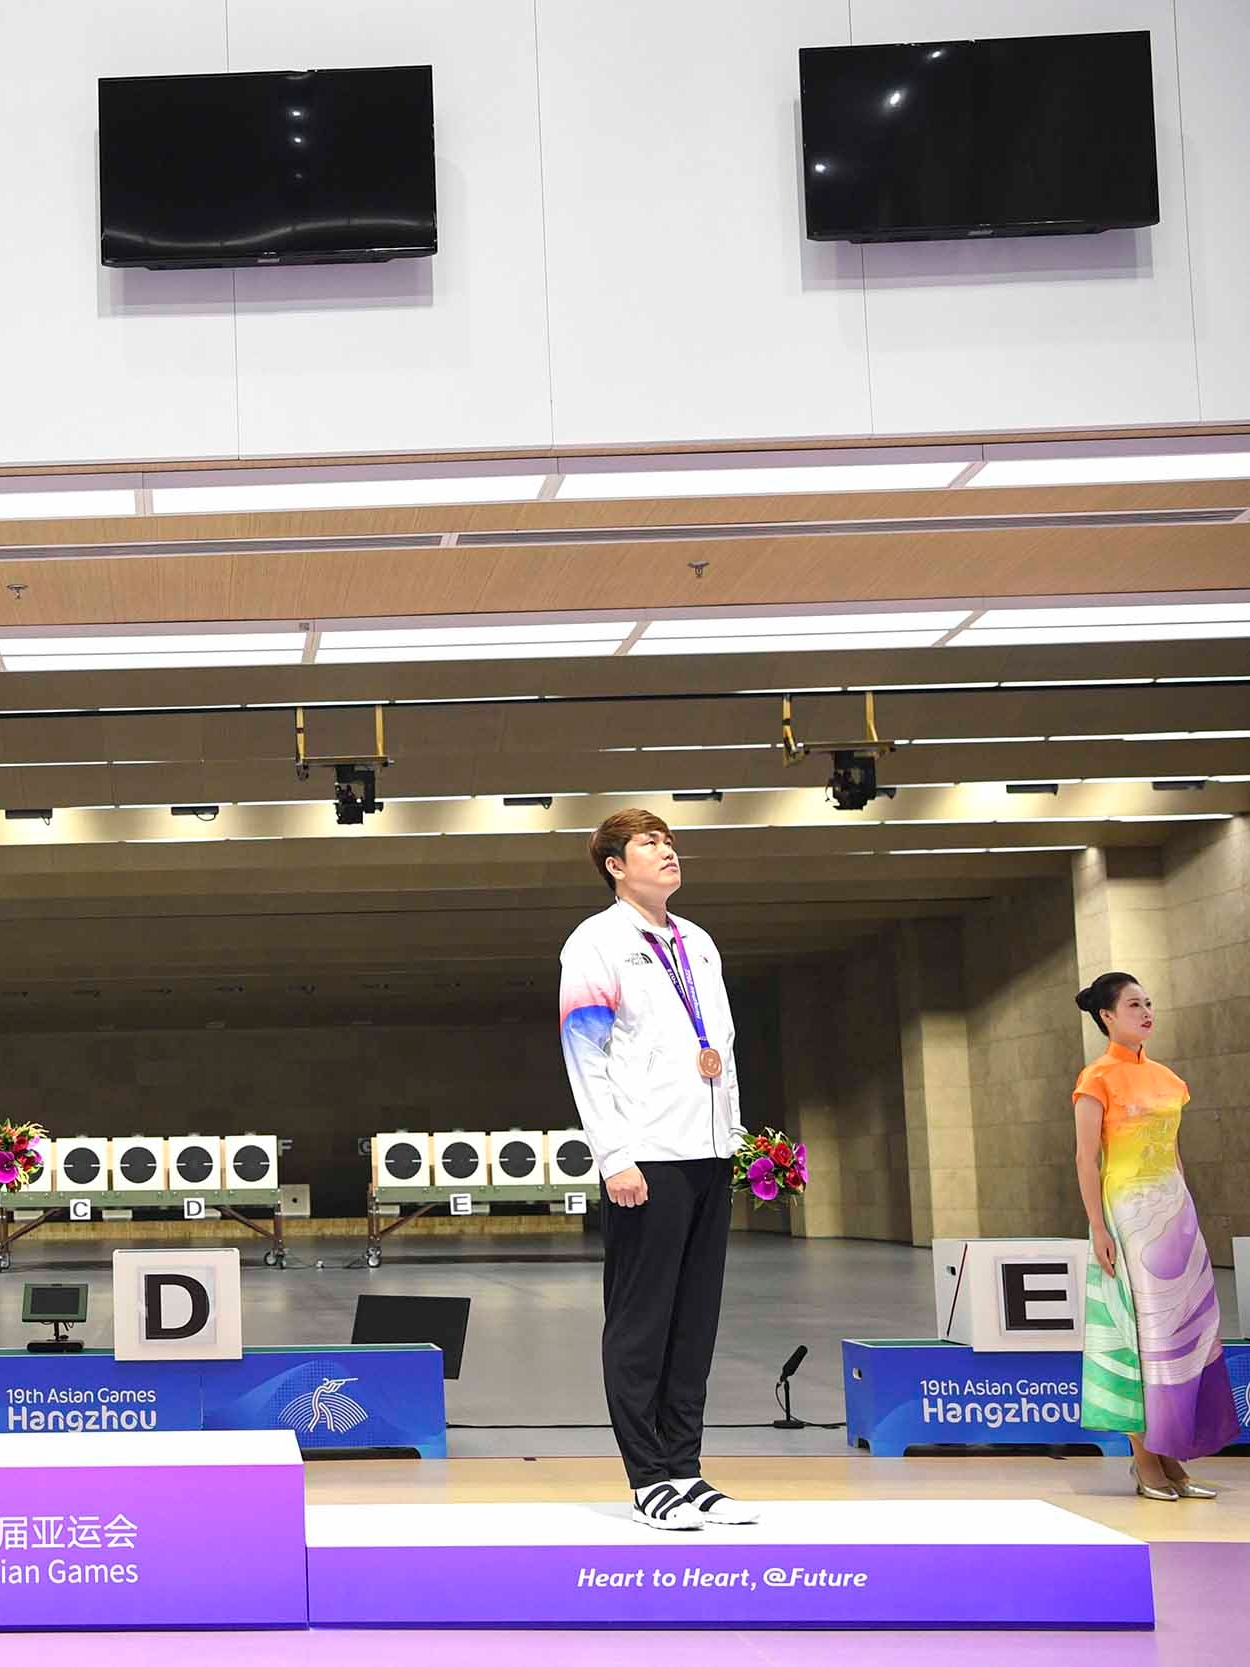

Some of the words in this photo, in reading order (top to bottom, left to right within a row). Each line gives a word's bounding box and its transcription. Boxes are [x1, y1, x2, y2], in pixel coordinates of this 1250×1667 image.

[72, 1201, 89, 1218] C
[184, 1200, 203, 1218] D
[452, 1195, 470, 1213] E
[565, 1195, 583, 1213] F
[144, 1273, 211, 1341] D
[1001, 1262, 1075, 1331] E
[6, 1388, 44, 1404] 19th
[47, 1388, 94, 1404] Asian
[97, 1387, 157, 1404] Games
[919, 1379, 960, 1396] 19th
[963, 1379, 1013, 1396] Asian
[1016, 1379, 1079, 1396] Games
[7, 1405, 157, 1432] Hangzhou
[922, 1397, 1082, 1428] Hangzhou
[48, 1558, 139, 1584] Games
[577, 1568, 645, 1587] Heart
[652, 1568, 677, 1587] to
[682, 1567, 757, 1591] Heart,
[762, 1567, 868, 1588] @Future
